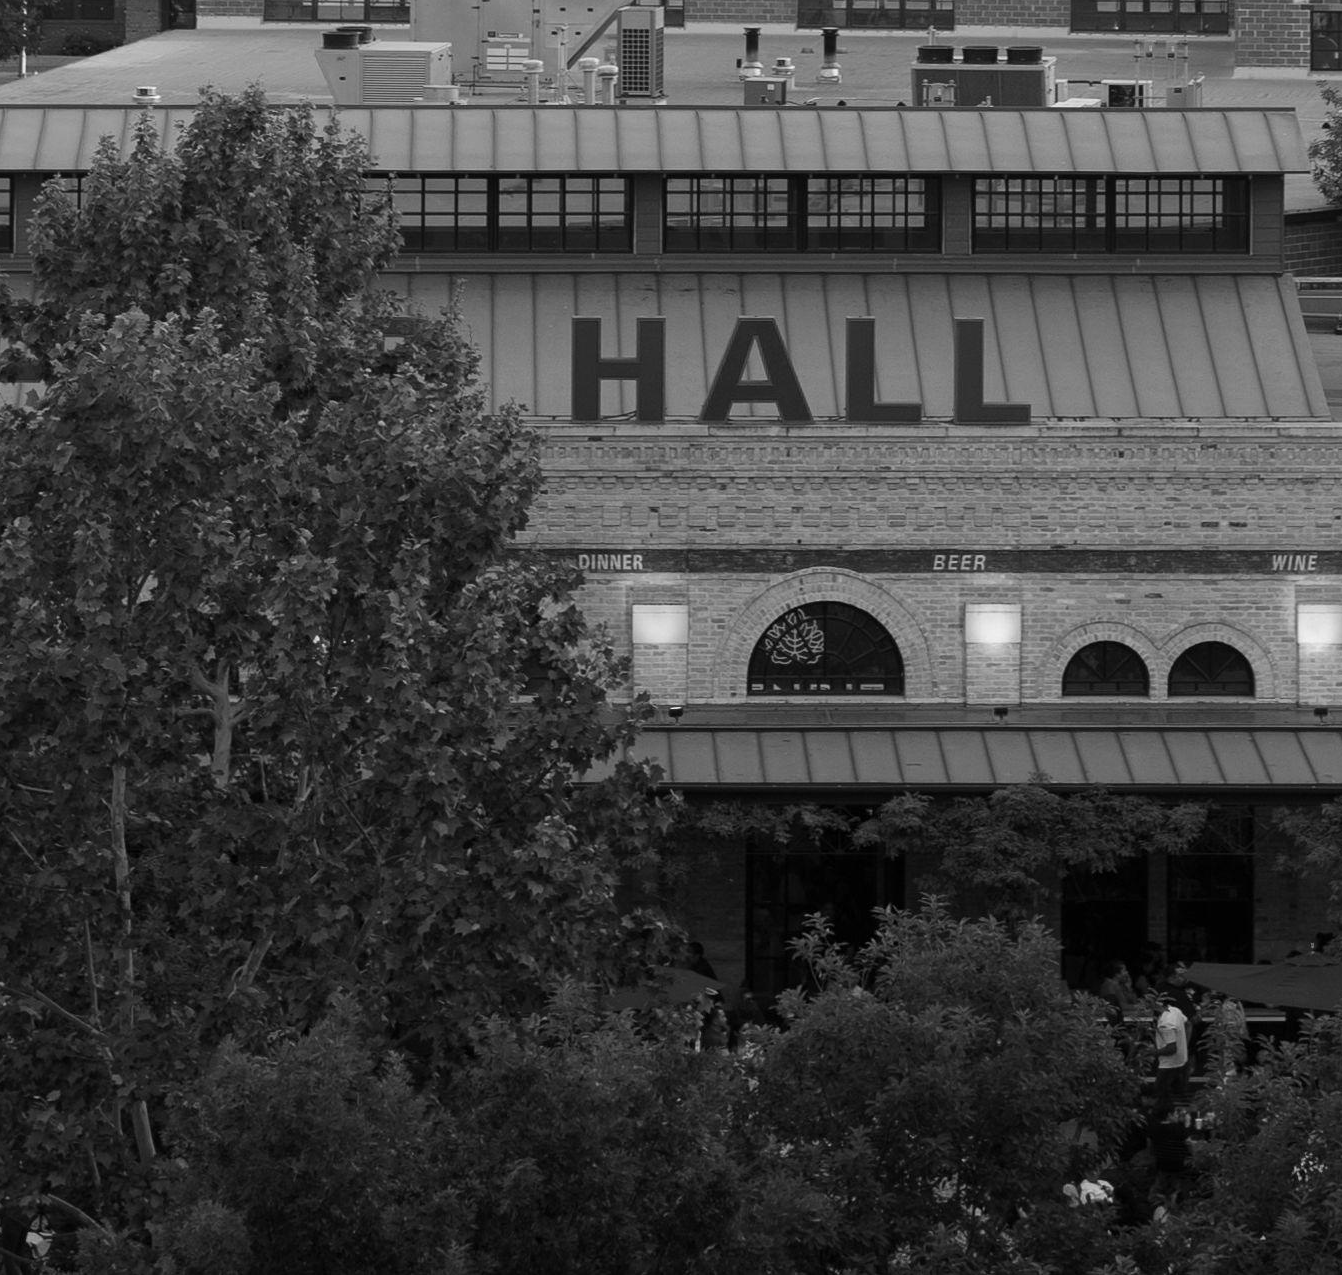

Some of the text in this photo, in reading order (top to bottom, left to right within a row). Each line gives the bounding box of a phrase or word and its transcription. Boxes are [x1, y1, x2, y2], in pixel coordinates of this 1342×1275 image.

[570, 315, 1031, 424] HALL
[578, 554, 644, 570] DINNER
[933, 554, 986, 570] BEER
[1272, 555, 1319, 571] WINE
